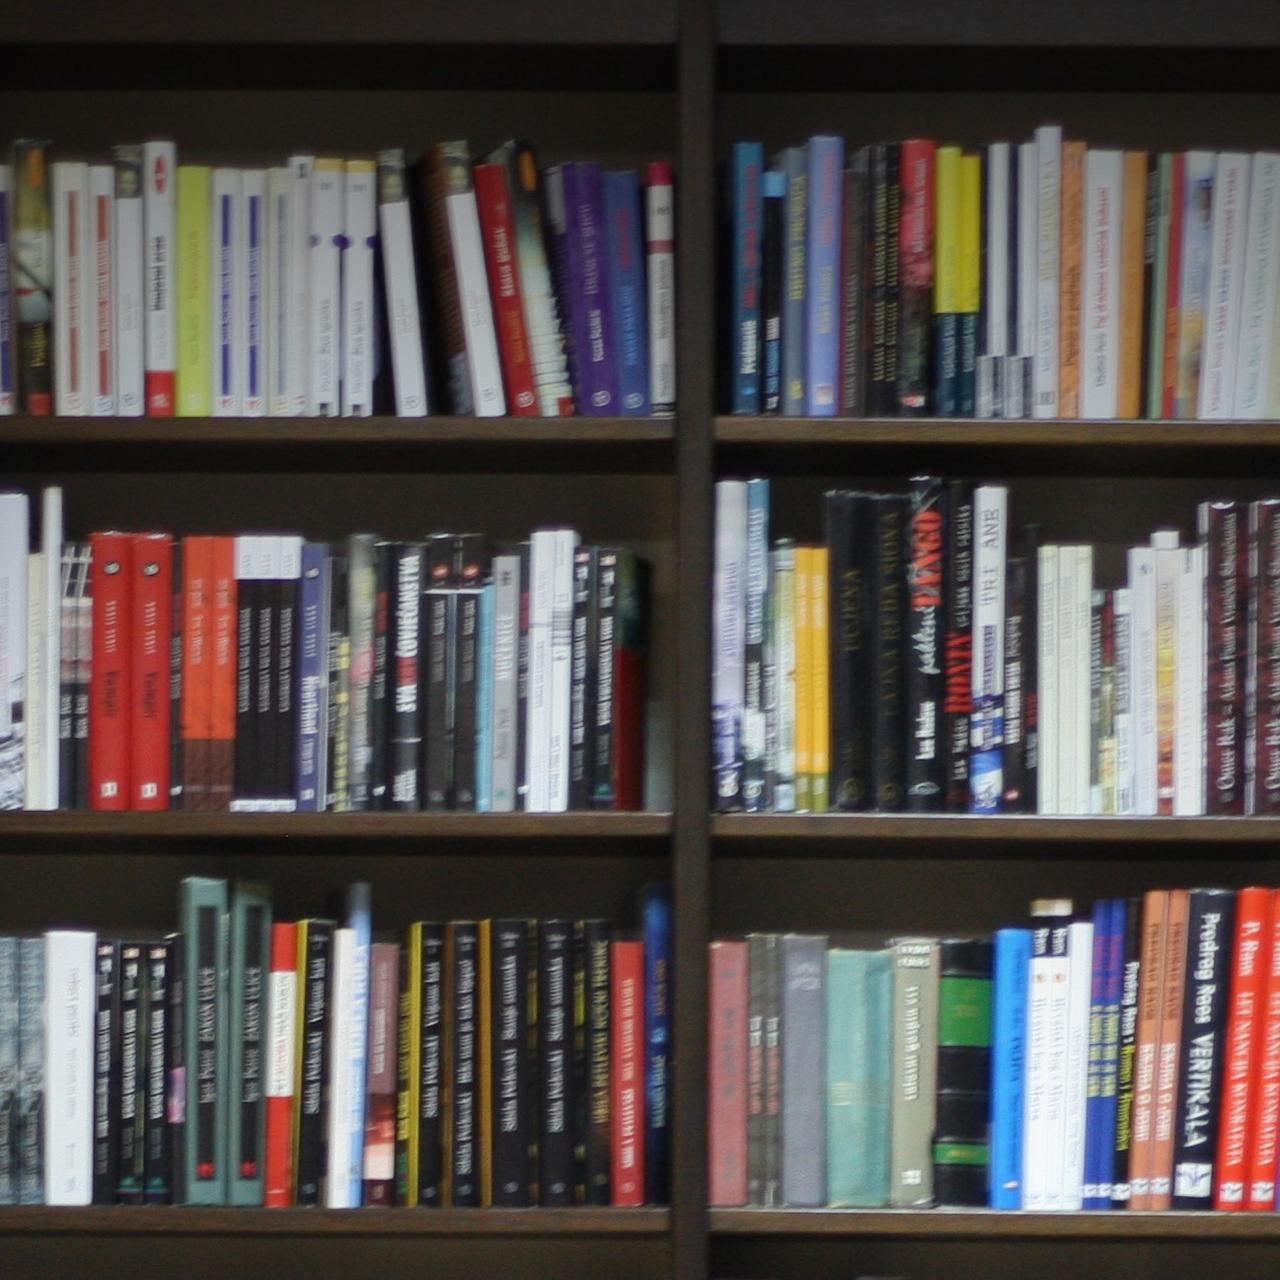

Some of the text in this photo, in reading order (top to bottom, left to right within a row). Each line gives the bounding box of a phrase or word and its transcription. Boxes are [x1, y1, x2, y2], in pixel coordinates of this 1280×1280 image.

[1184, 913, 1223, 1148] Predrag Raos VERTIKALA
